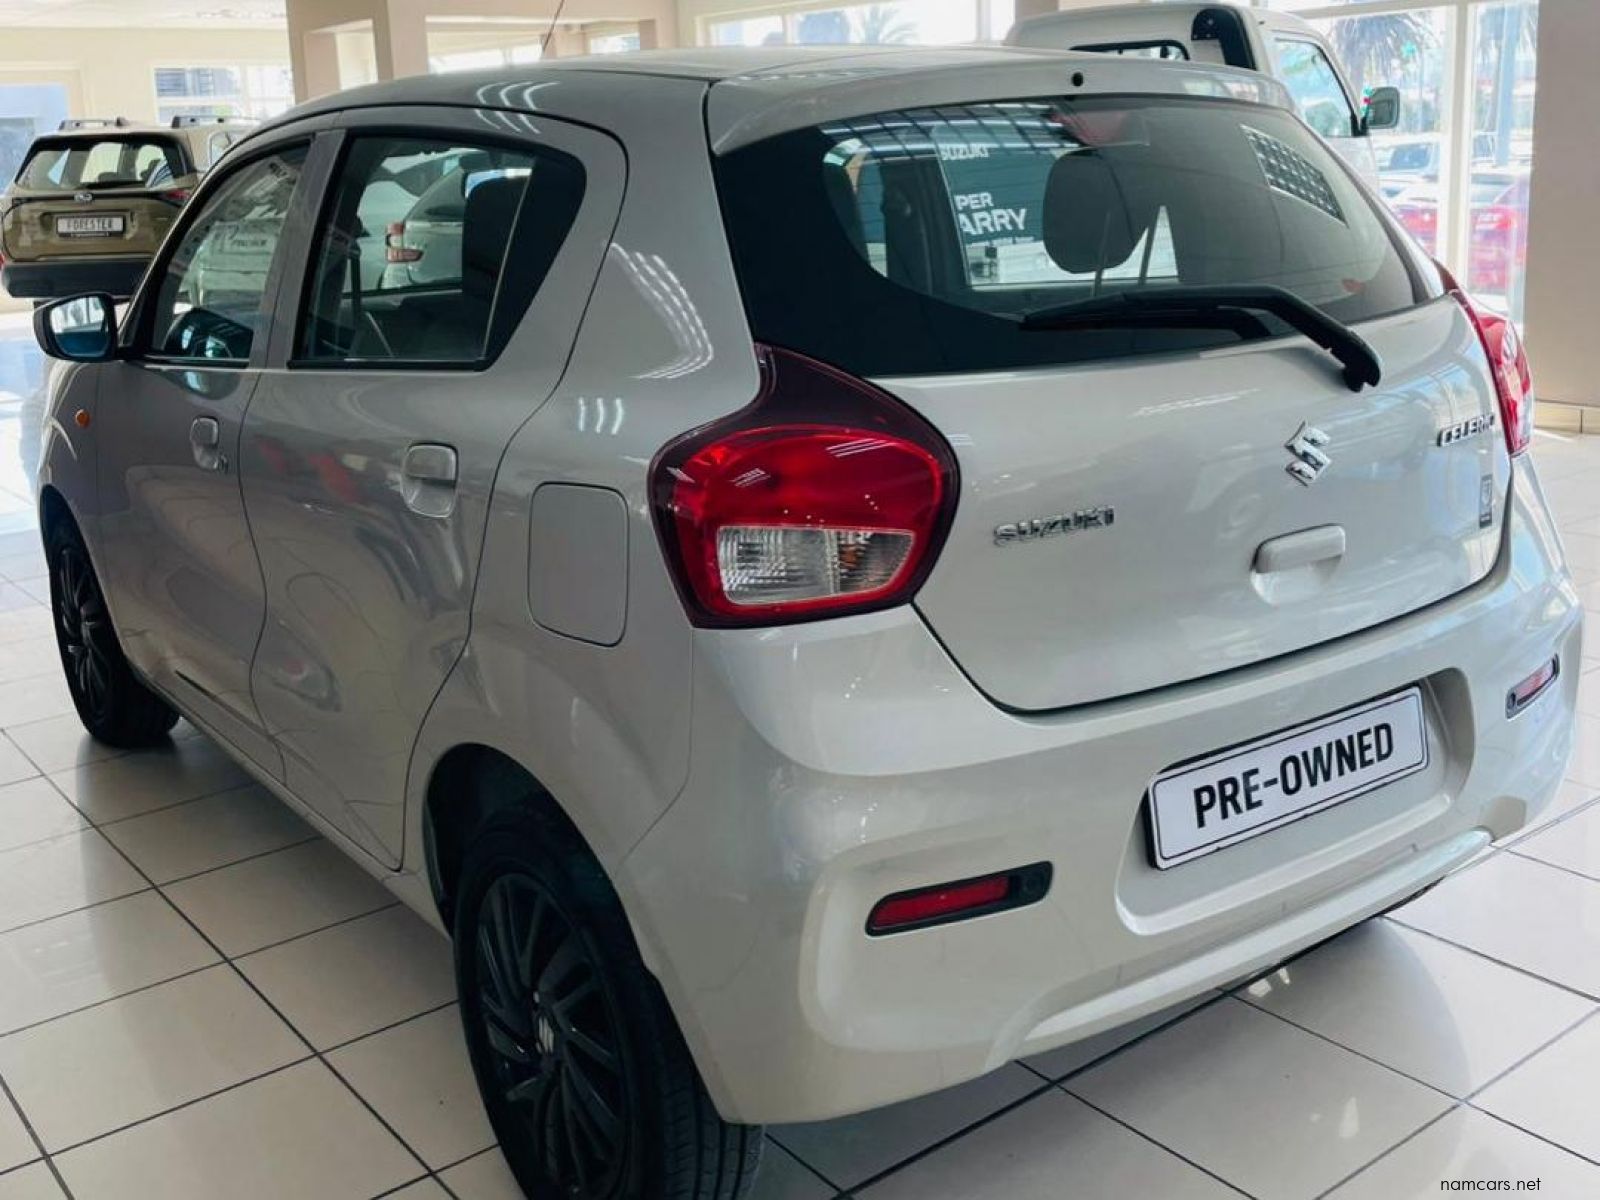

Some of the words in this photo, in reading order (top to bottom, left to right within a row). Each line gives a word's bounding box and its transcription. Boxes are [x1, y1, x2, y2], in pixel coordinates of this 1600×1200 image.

[953, 191, 994, 211] PER
[958, 207, 1027, 235] ARRY
[993, 505, 1115, 546] SUZUKI
[1193, 722, 1394, 829] PRE-OWNED
